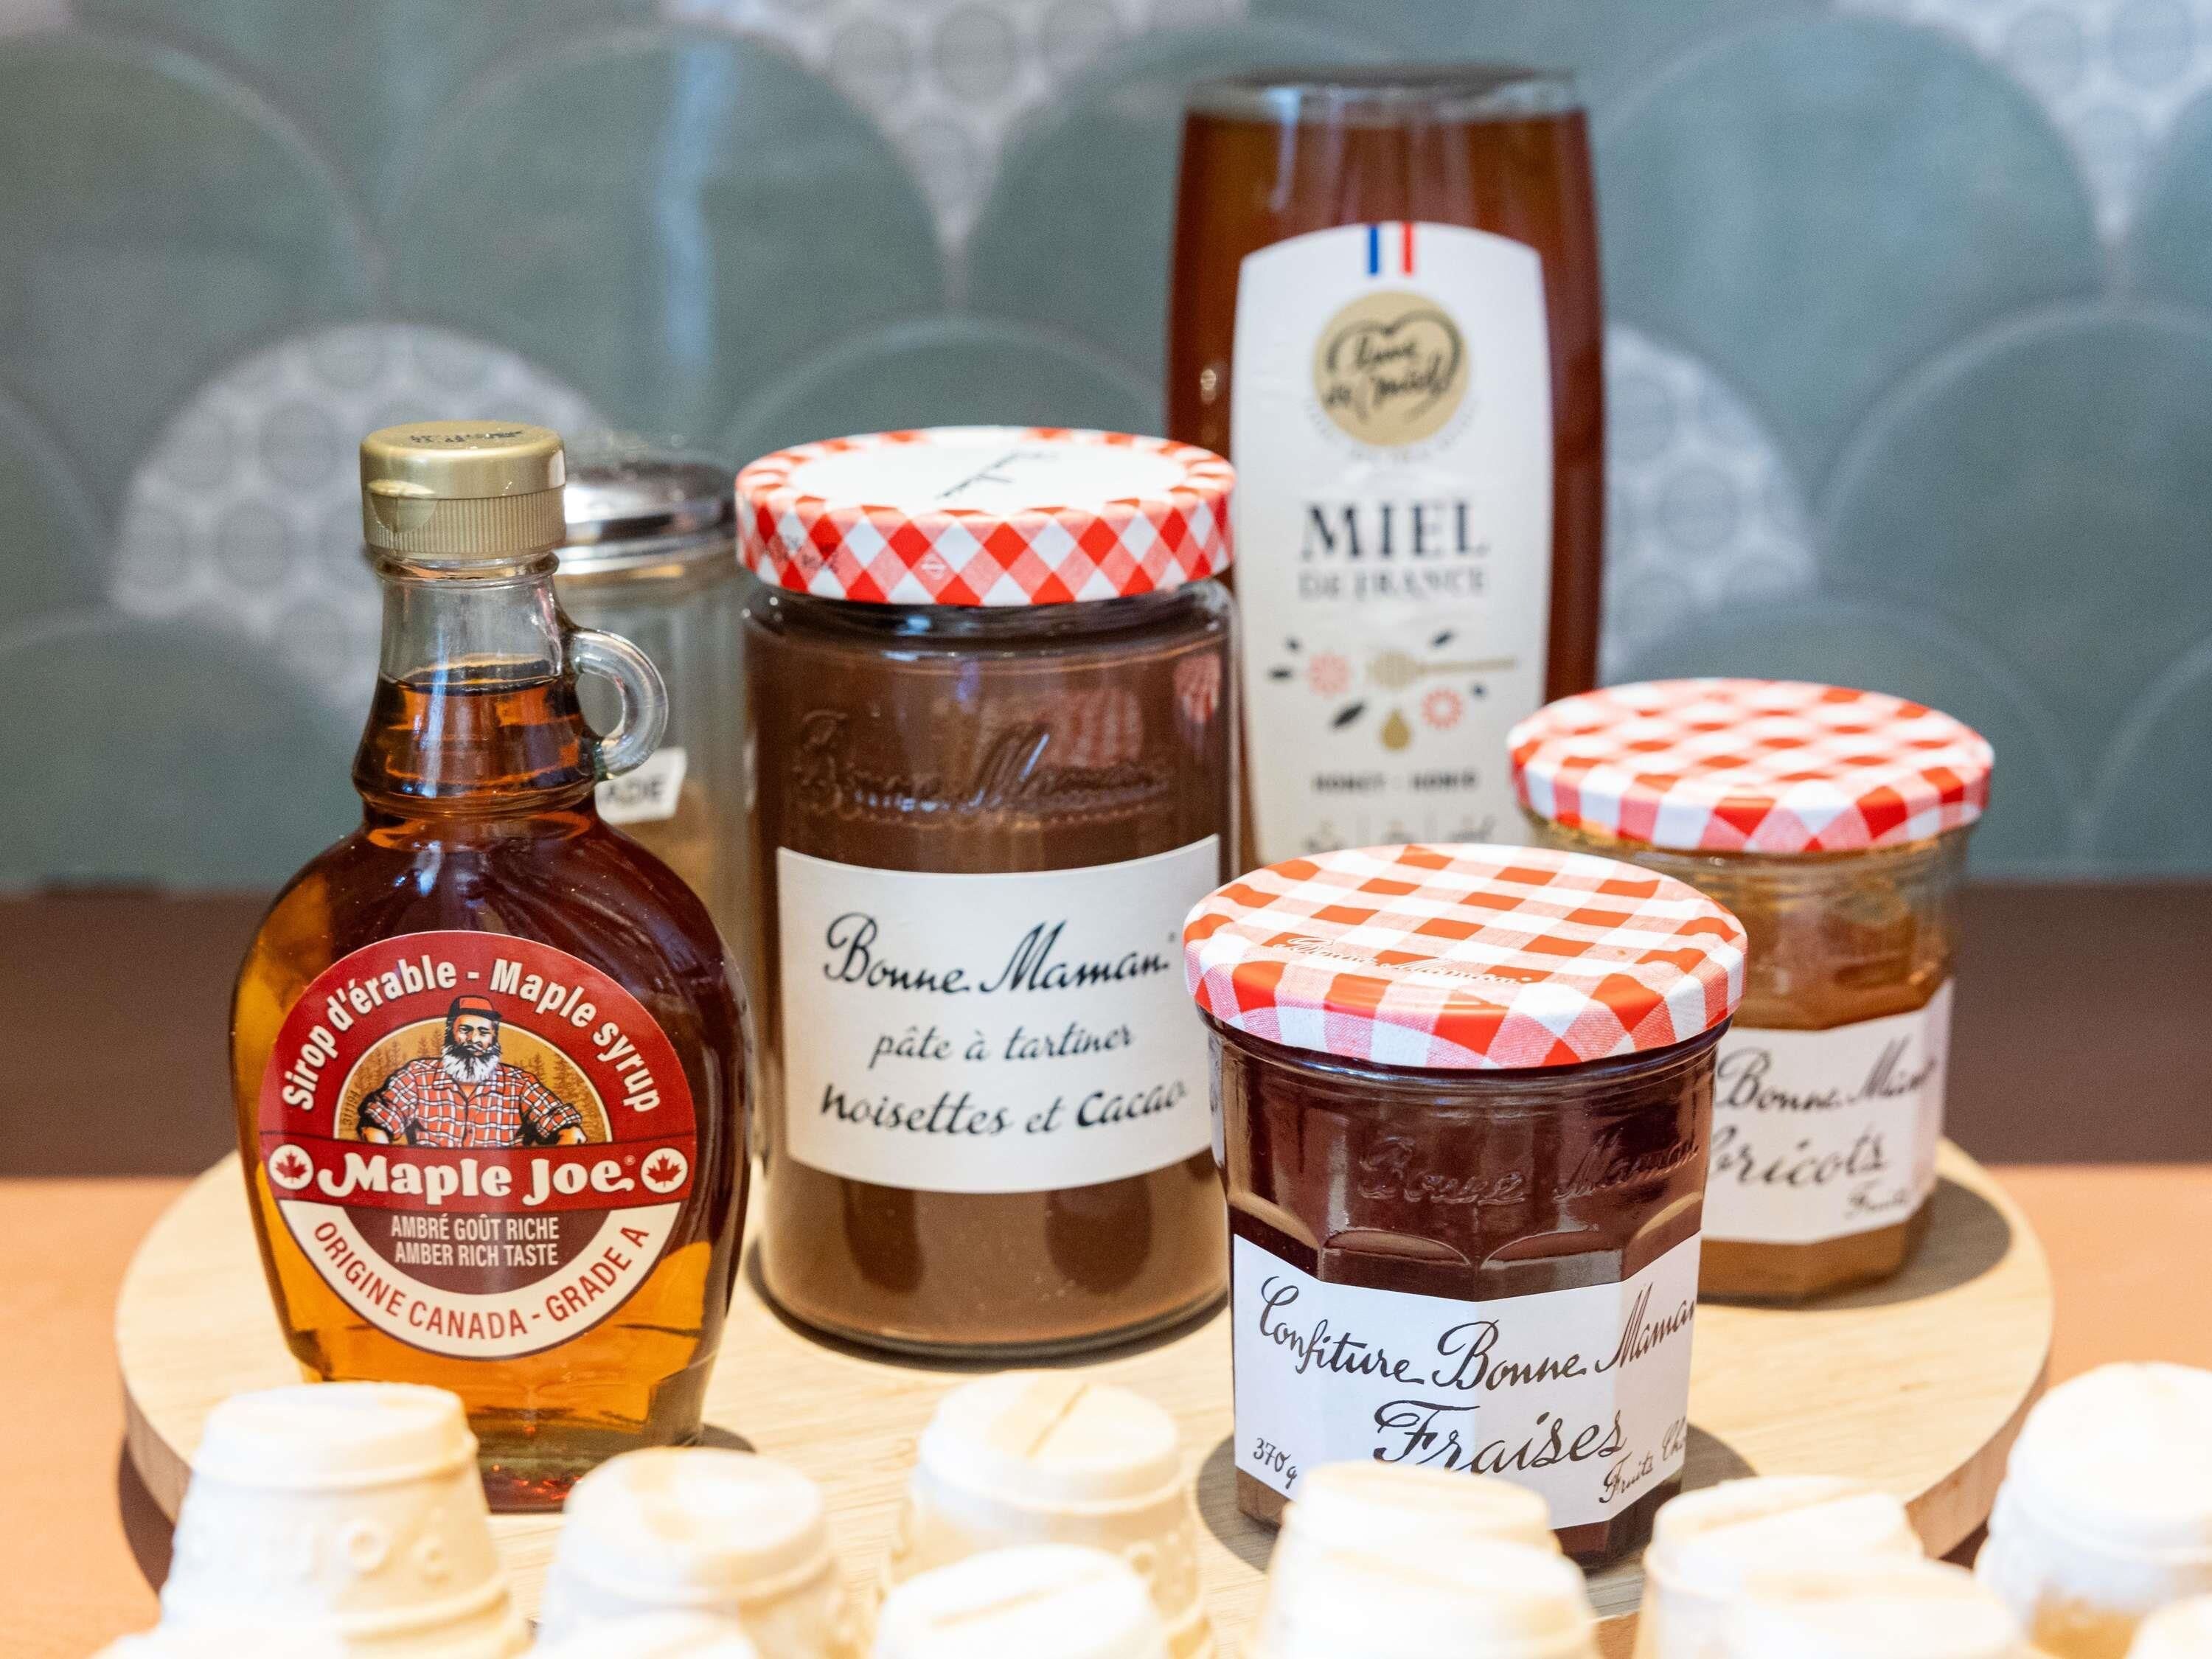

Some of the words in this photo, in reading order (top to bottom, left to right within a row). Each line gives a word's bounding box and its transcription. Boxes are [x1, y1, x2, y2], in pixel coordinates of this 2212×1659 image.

[1300, 498, 1491, 562] MIEL
[824, 911, 971, 995] Bonne
[978, 919, 1169, 994] Maman
[326, 955, 457, 1033] d'érable
[489, 958, 597, 1029] Maple
[592, 1020, 661, 1112] syrup
[868, 1027, 953, 1069] pâte
[964, 1030, 990, 1062] à
[1003, 1022, 1136, 1060] tartiner
[1025, 1096, 1062, 1134] et
[317, 1152, 512, 1208] Maple
[522, 1158, 635, 1206] Joe
[391, 1215, 449, 1241] AMBRÉ
[453, 1214, 501, 1241] GOÛT
[506, 1217, 559, 1241] RICHE
[394, 1242, 453, 1265] AMBER
[458, 1243, 500, 1266] RICH
[504, 1243, 559, 1267] TASTE
[313, 1221, 407, 1319] ORIGINE
[408, 1301, 528, 1340] CANADA
[545, 1259, 631, 1324] GRADE
[627, 1226, 649, 1249] A
[1260, 1276, 1425, 1385] Confiture
[1431, 1319, 1587, 1391] Bonne
[1253, 1437, 1292, 1472] 370
[1374, 1399, 1628, 1473] Fraises
[1599, 1450, 1654, 1503] Fruits
